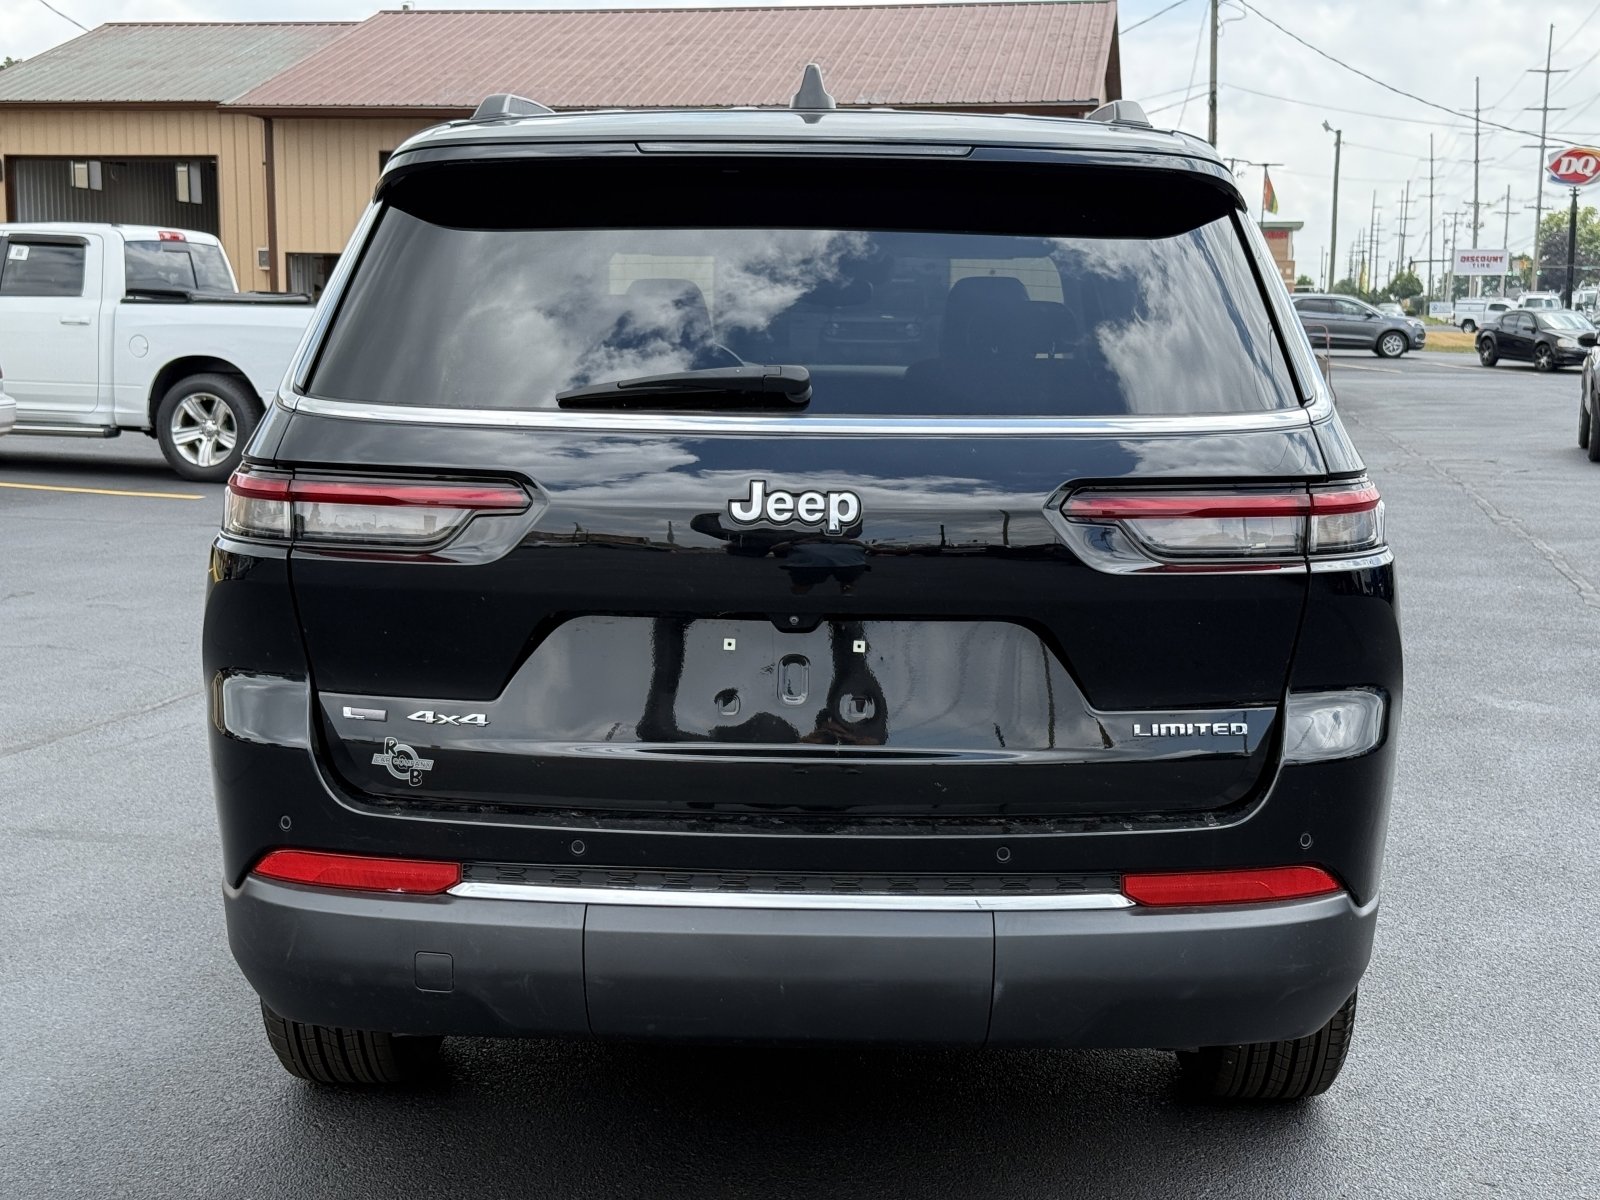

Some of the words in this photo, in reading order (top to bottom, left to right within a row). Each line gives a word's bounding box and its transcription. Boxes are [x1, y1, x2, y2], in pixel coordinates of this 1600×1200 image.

[1557, 155, 1596, 177] DQ
[1460, 255, 1504, 263] DISCOUNT
[730, 480, 860, 533] Jeep
[1132, 722, 1249, 737] LIMITED
[384, 736, 398, 756] R
[409, 768, 422, 786] B
